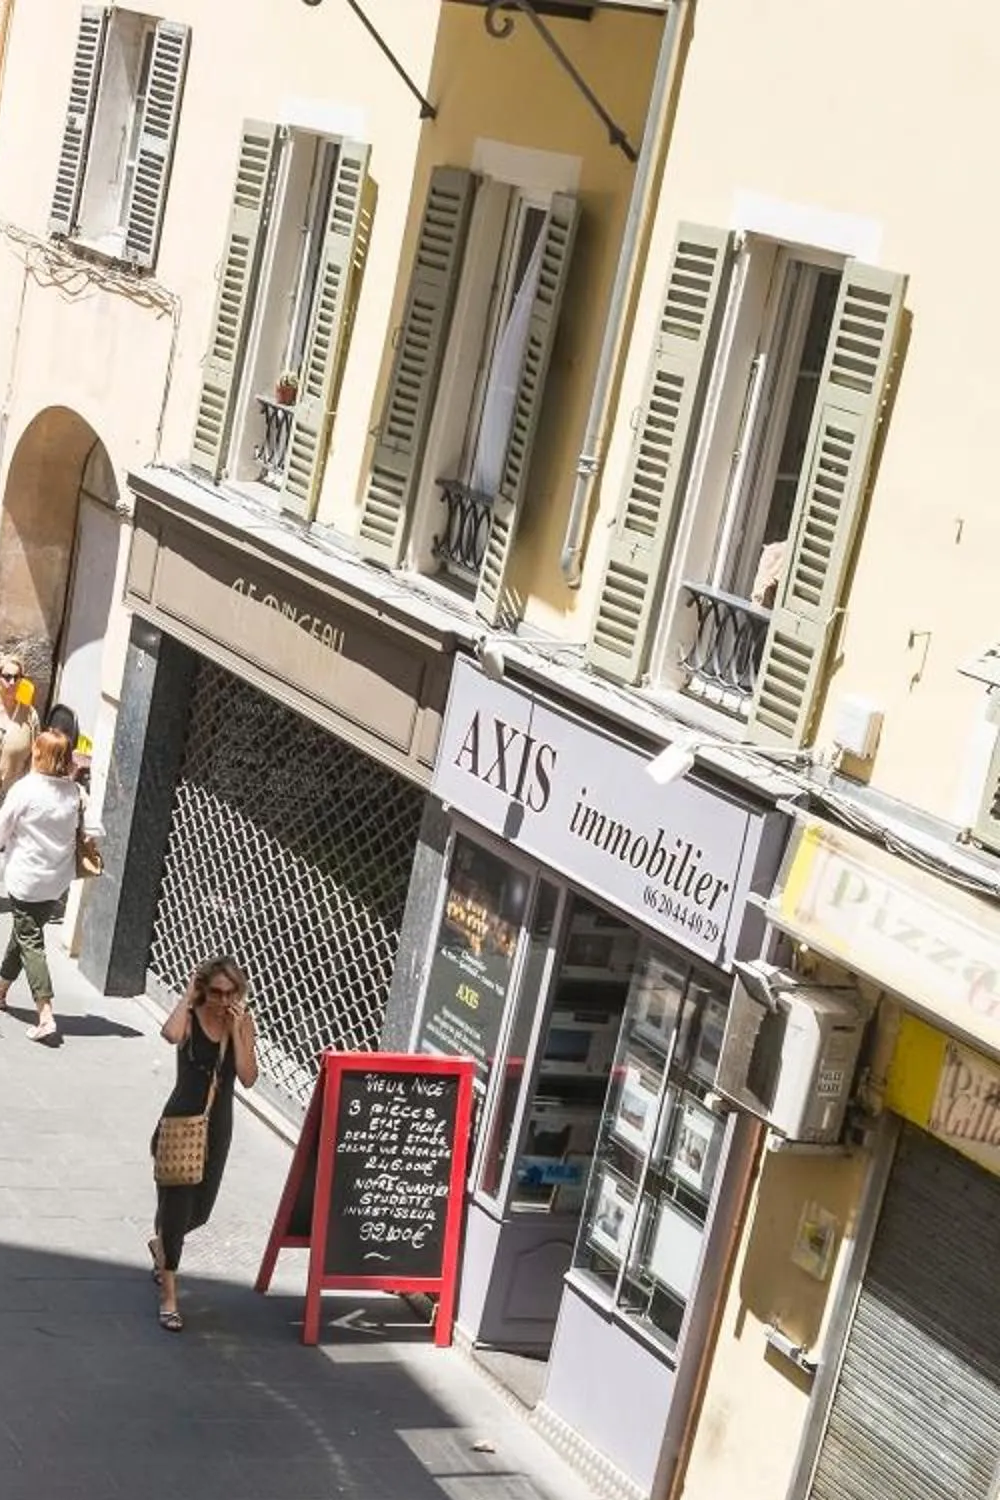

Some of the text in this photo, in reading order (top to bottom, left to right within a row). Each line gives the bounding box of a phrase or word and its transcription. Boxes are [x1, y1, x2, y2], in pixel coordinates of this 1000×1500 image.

[454, 709, 730, 912] AXIS immobilier
[826, 868, 998, 992] Pizza
[456, 983, 479, 1010] AXIS
[411, 1077, 445, 1097] NICE
[349, 1099, 361, 1116] 3
